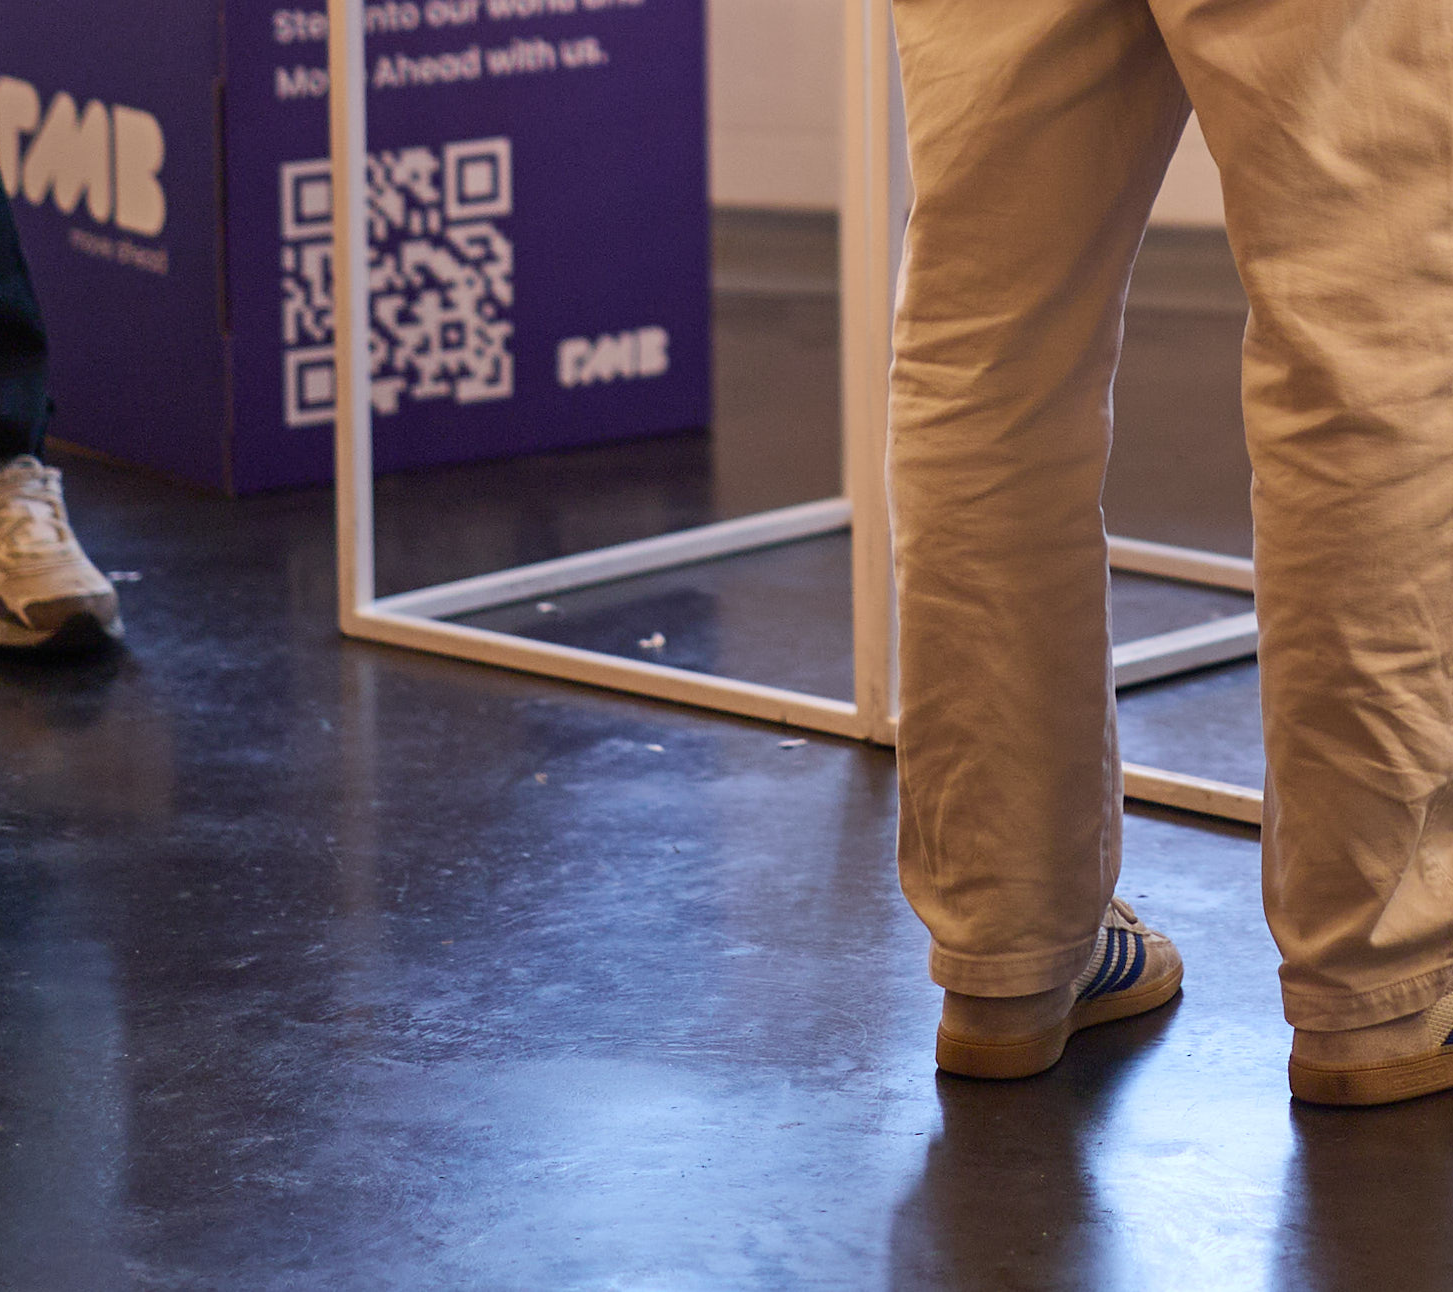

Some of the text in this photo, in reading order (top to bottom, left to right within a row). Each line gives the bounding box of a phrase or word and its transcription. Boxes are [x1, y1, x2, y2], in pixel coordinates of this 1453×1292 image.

[364, 0, 420, 34] nto
[372, 44, 482, 89] Ahead
[485, 36, 558, 76] with
[559, 36, 609, 69] us.
